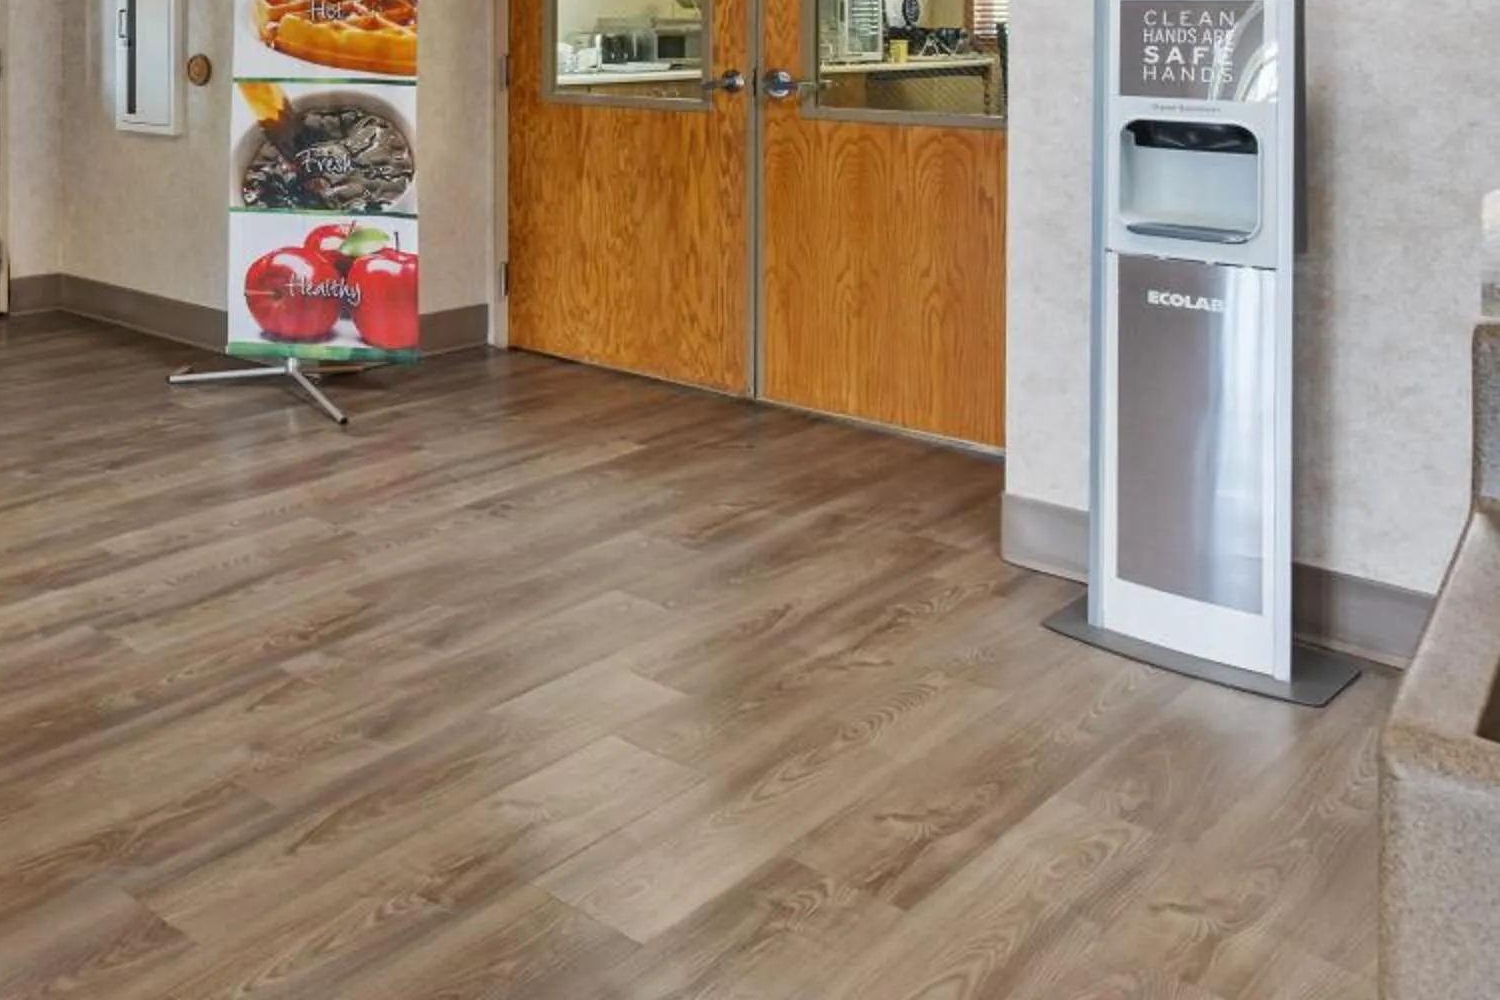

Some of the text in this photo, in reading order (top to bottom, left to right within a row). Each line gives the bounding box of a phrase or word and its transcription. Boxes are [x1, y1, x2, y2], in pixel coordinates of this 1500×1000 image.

[310, 0, 343, 20] Hot
[1143, 9, 1235, 27] CLEAN
[1143, 27, 1234, 47] HANDS ARE
[1143, 45, 1234, 66] SAFE
[1143, 65, 1234, 83] HANDS
[296, 148, 352, 173] Fresh
[284, 272, 361, 307] Healthy
[1147, 289, 1223, 313] ECOLAB
